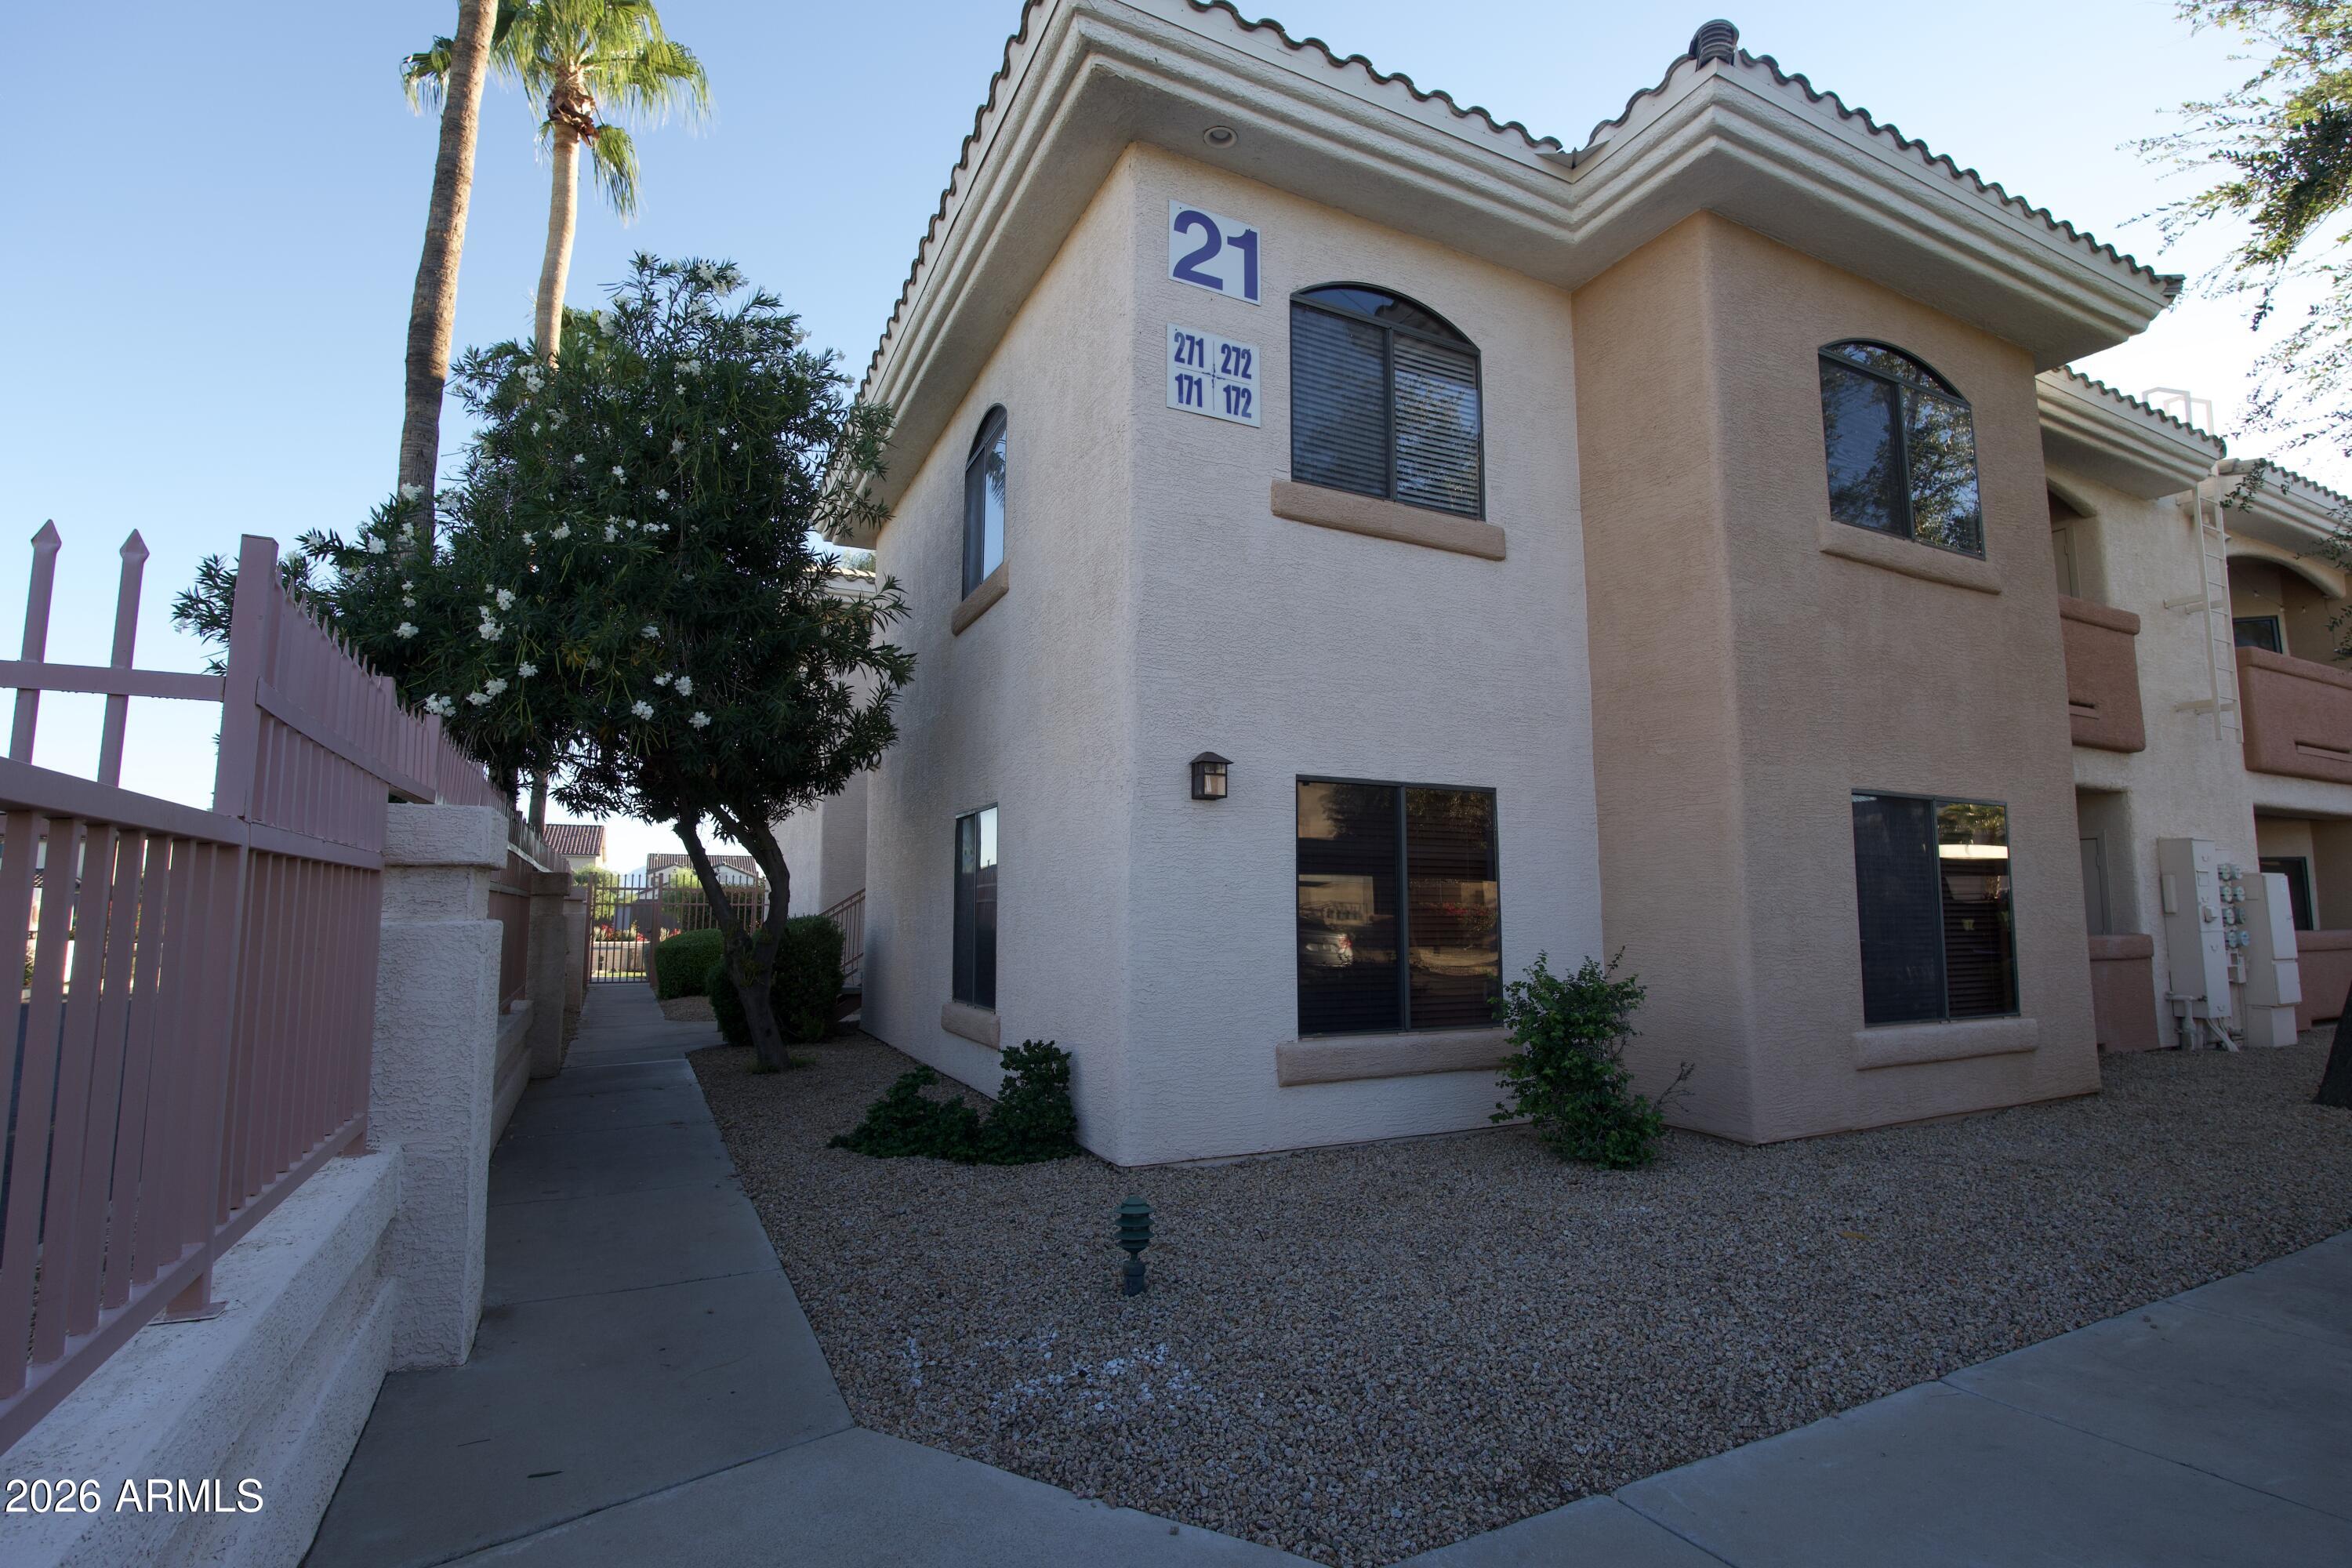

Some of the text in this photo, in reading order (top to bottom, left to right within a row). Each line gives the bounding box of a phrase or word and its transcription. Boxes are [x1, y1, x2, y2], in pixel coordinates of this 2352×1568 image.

[1173, 209, 1258, 301] 21
[1174, 332, 1252, 379] 271 272
[1175, 373, 1252, 419] 171 172
